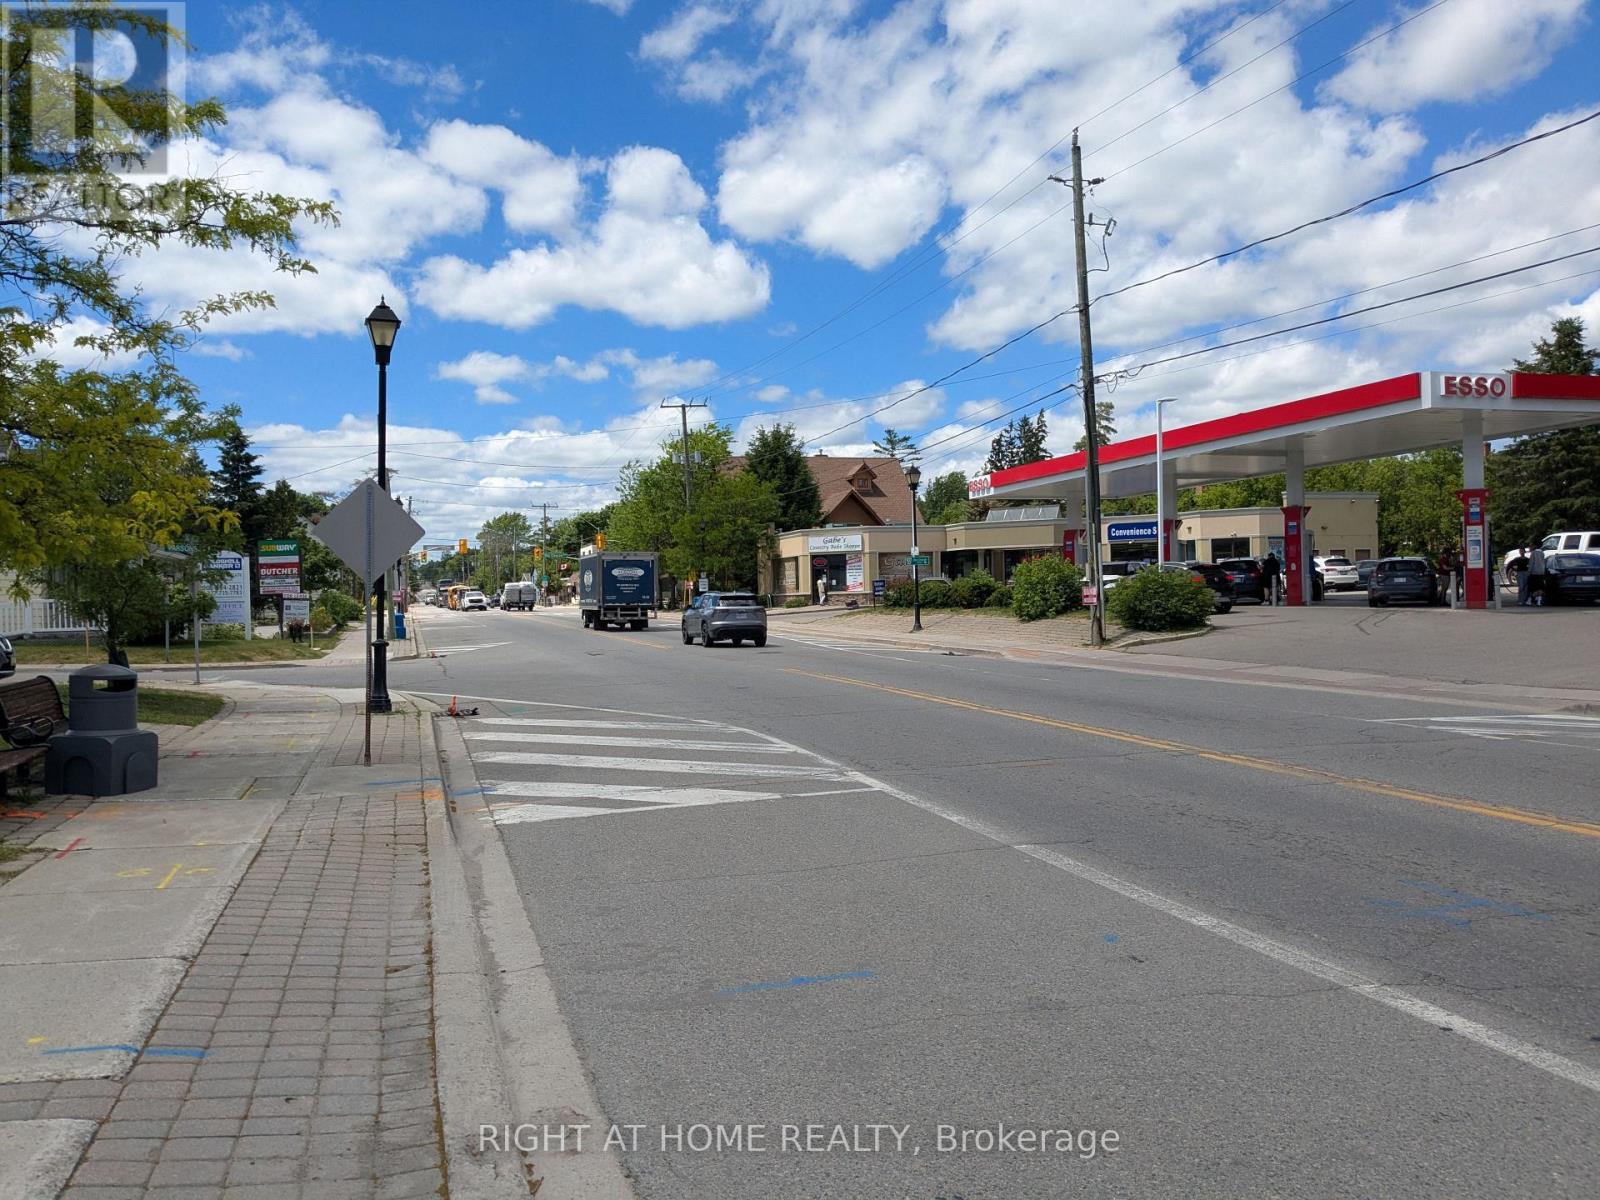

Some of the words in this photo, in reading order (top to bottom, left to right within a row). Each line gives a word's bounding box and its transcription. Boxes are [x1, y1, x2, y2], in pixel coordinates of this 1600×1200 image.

[1443, 376, 1506, 397] ESSO
[1111, 527, 1151, 537] Convenience
[822, 536, 846, 545] Gabe's
[260, 543, 297, 551] SUBWAY
